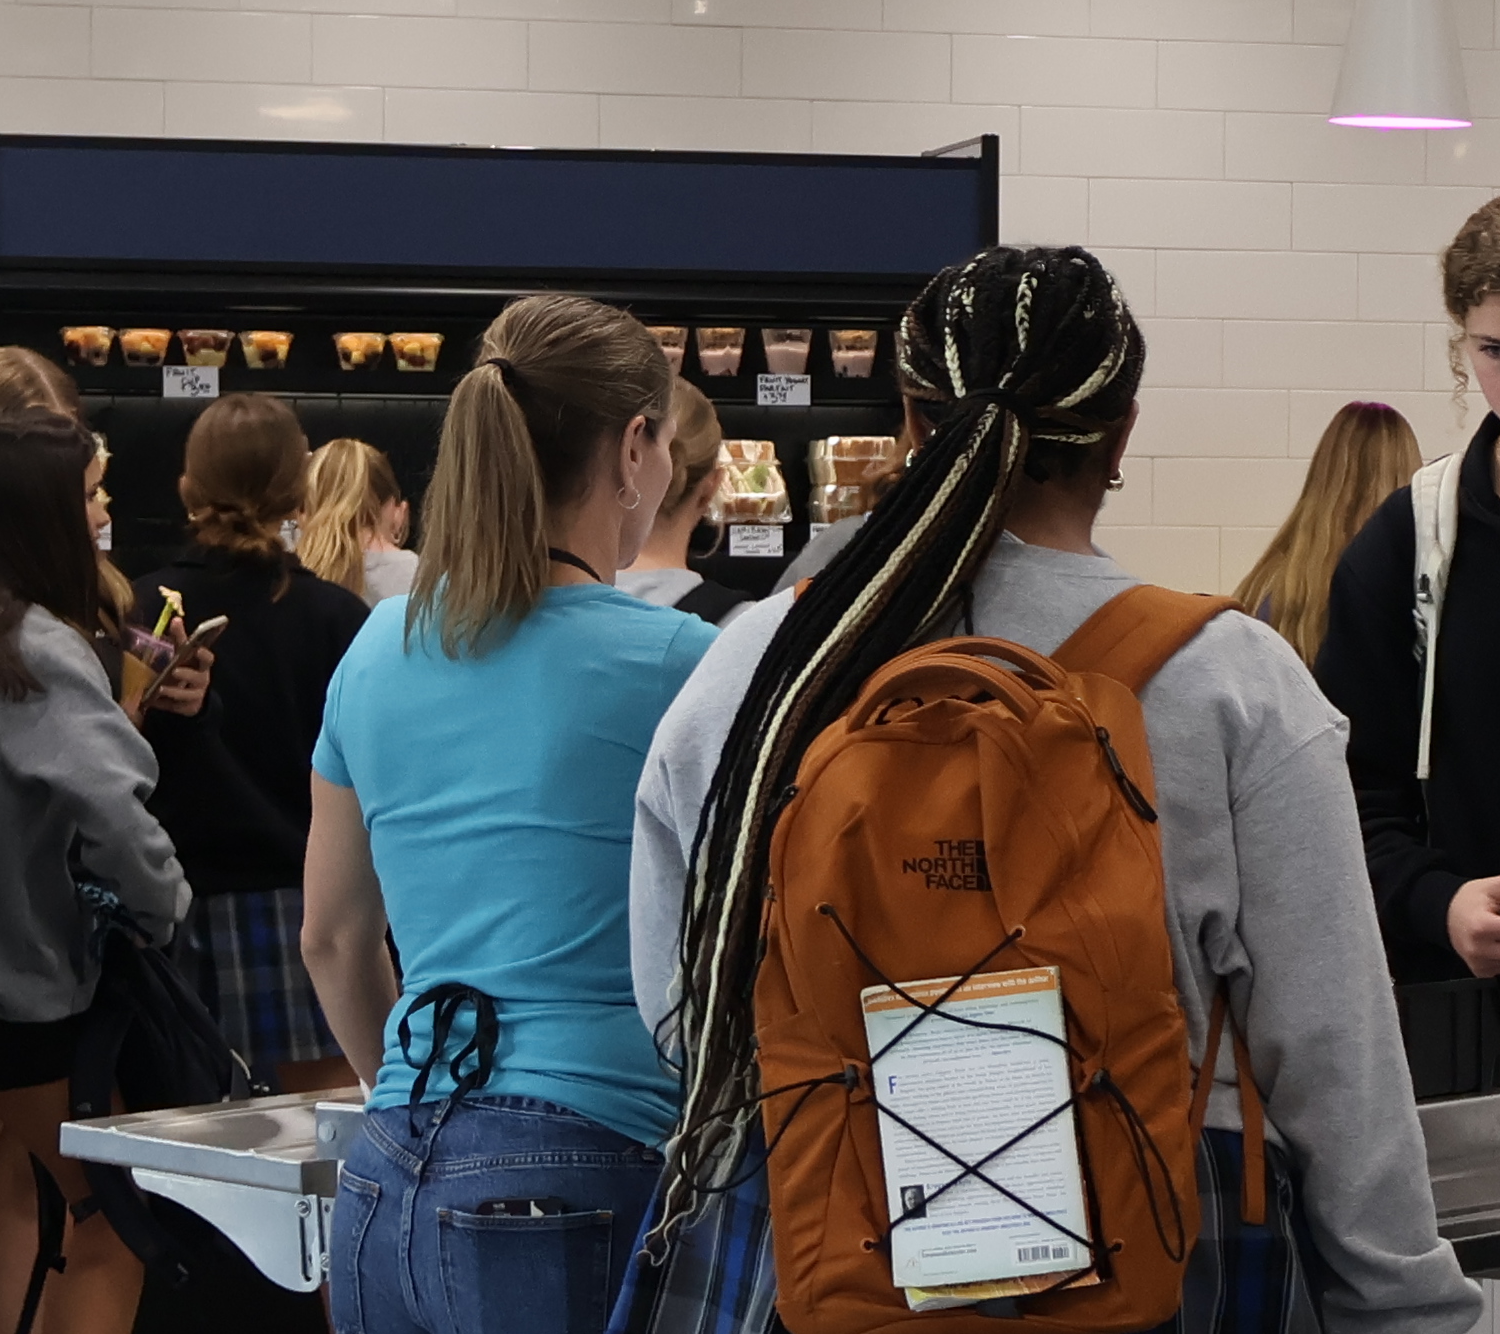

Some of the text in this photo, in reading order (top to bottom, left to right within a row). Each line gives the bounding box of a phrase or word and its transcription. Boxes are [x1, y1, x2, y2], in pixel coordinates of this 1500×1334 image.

[934, 840, 975, 857] THE
[902, 857, 975, 874] NORTH
[925, 874, 977, 890] FACE
